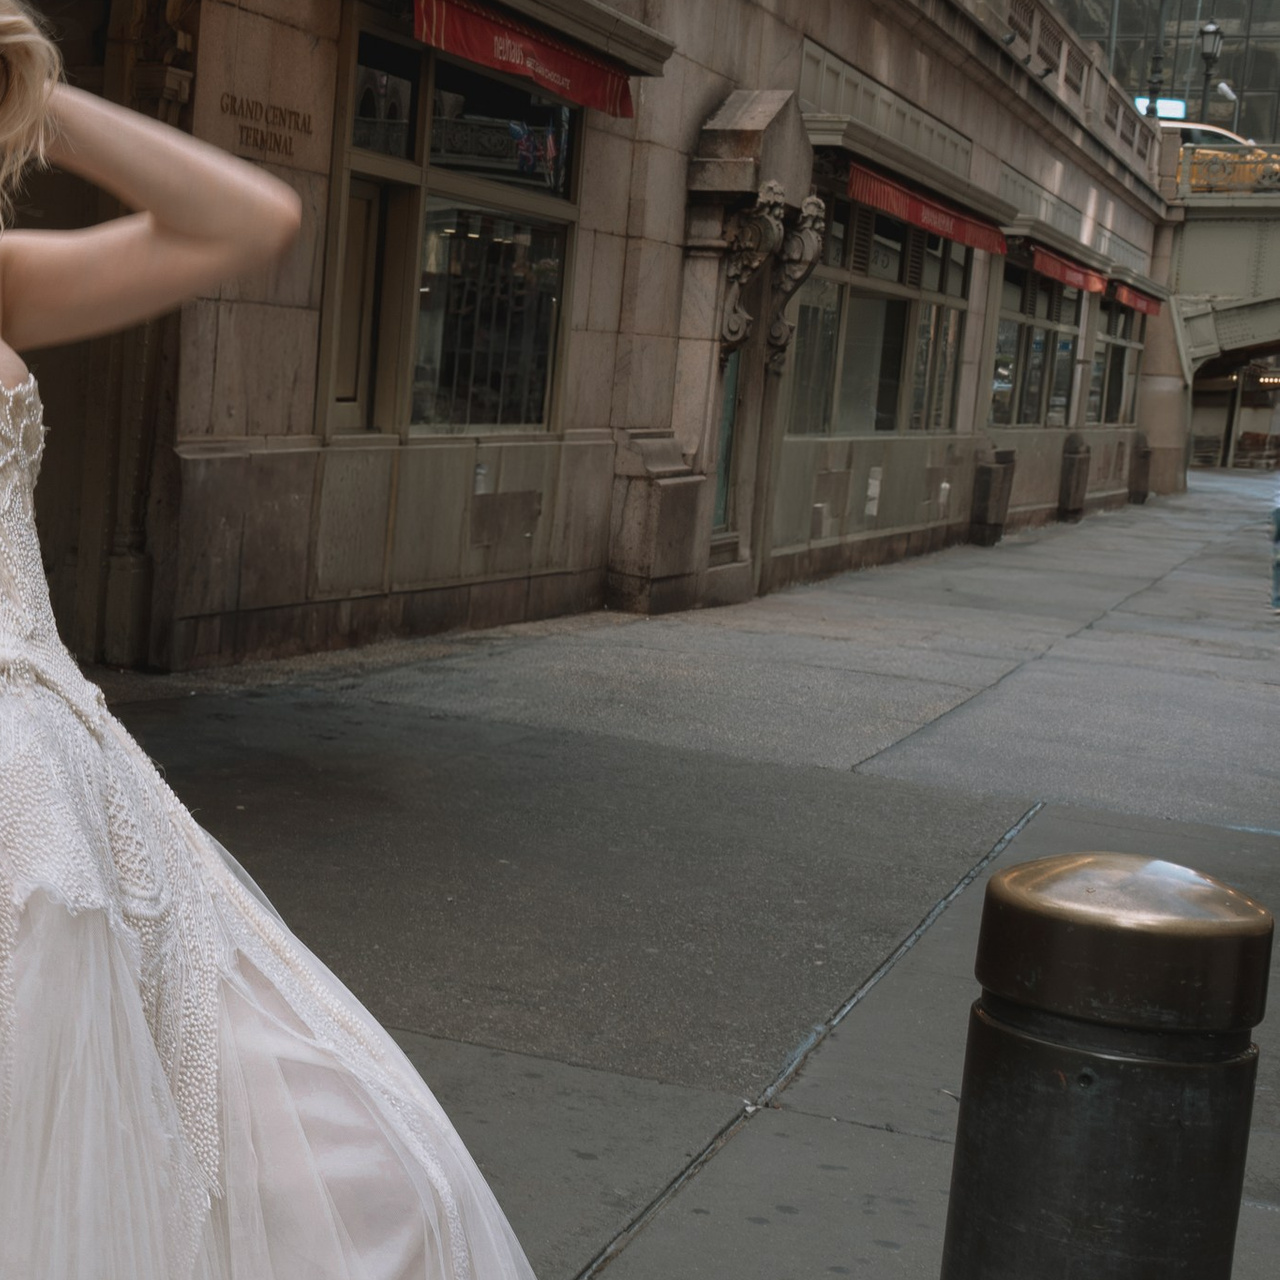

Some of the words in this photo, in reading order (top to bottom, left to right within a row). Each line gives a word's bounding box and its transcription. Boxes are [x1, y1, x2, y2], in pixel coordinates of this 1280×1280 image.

[494, 31, 524, 65] neuhaus
[220, 92, 264, 121] GRAND
[265, 104, 313, 135] CENTRAL
[239, 123, 294, 156] TERMINAL
